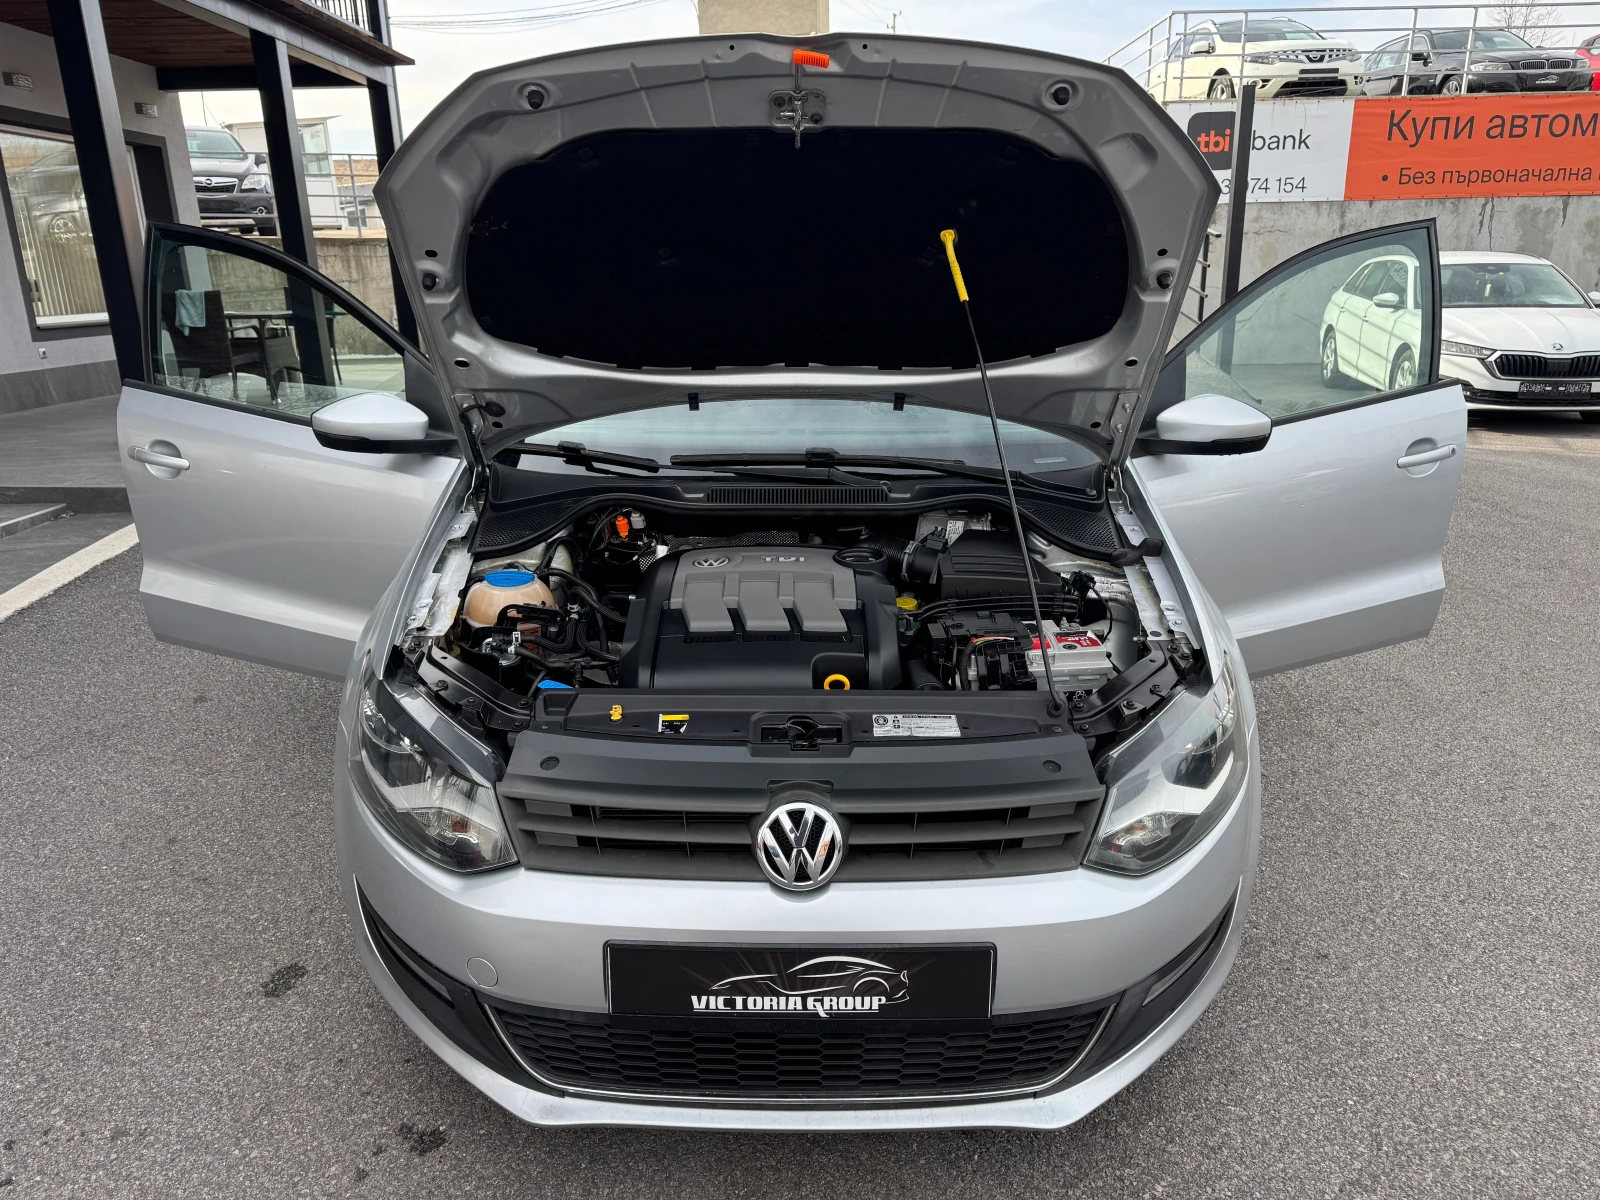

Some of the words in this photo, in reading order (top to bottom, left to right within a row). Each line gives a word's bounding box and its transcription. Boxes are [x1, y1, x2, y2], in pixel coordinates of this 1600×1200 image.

[1387, 109, 1475, 148] Купи
[1485, 112, 1599, 139] автом
[1197, 128, 1231, 153] tbi
[1251, 128, 1311, 151] bank
[1275, 176, 1307, 194] 154
[1398, 167, 1436, 185] Без
[1441, 166, 1593, 187] първоначална
[690, 995, 803, 1010] VICTORIA
[807, 995, 887, 1017] GROUP
